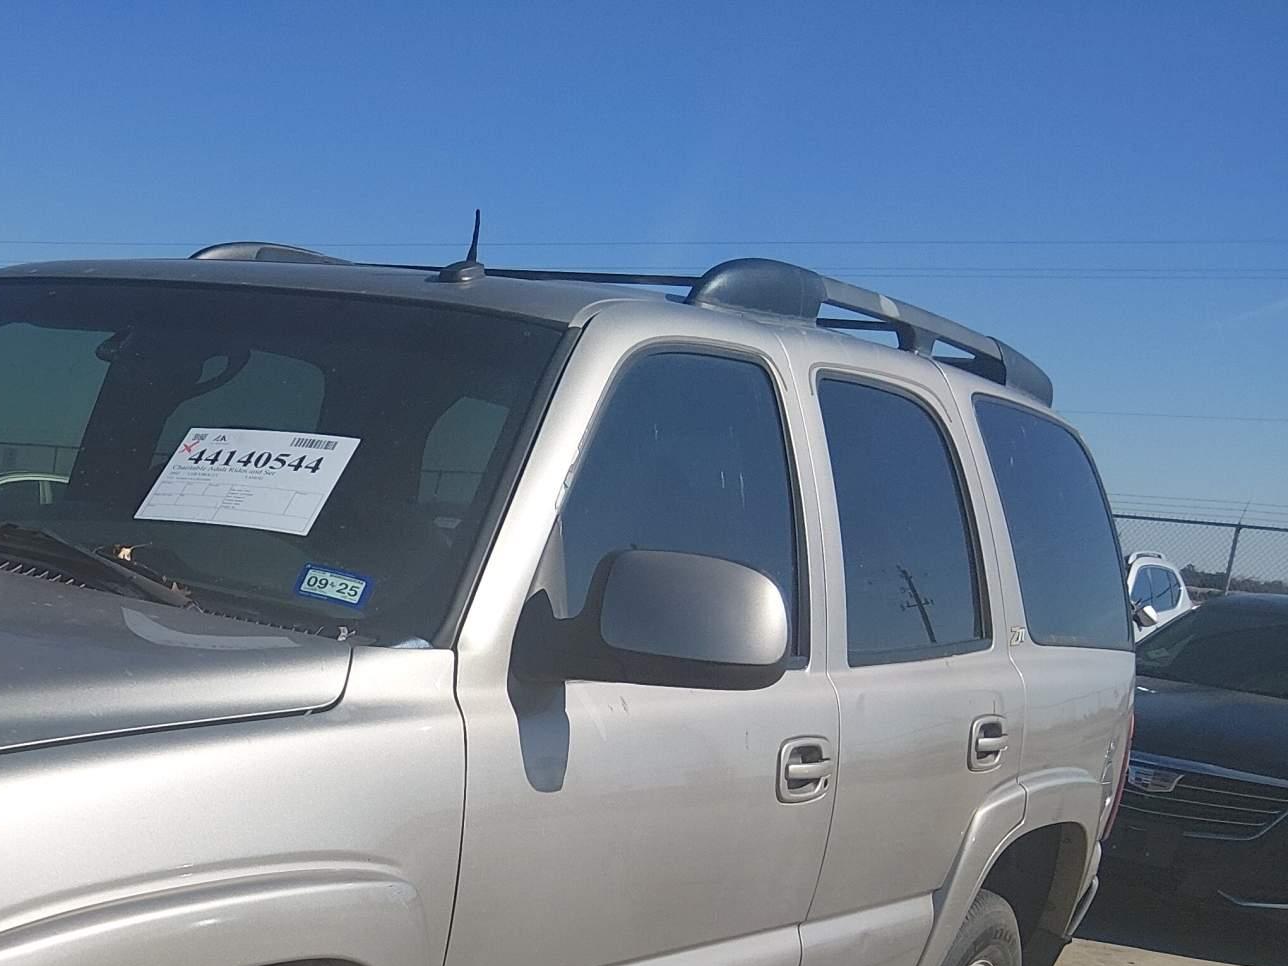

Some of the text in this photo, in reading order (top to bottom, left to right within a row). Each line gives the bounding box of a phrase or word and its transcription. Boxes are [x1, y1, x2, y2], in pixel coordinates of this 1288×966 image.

[188, 448, 324, 474] 44140544
[306, 575, 329, 589] 09
[335, 582, 360, 597] 25
